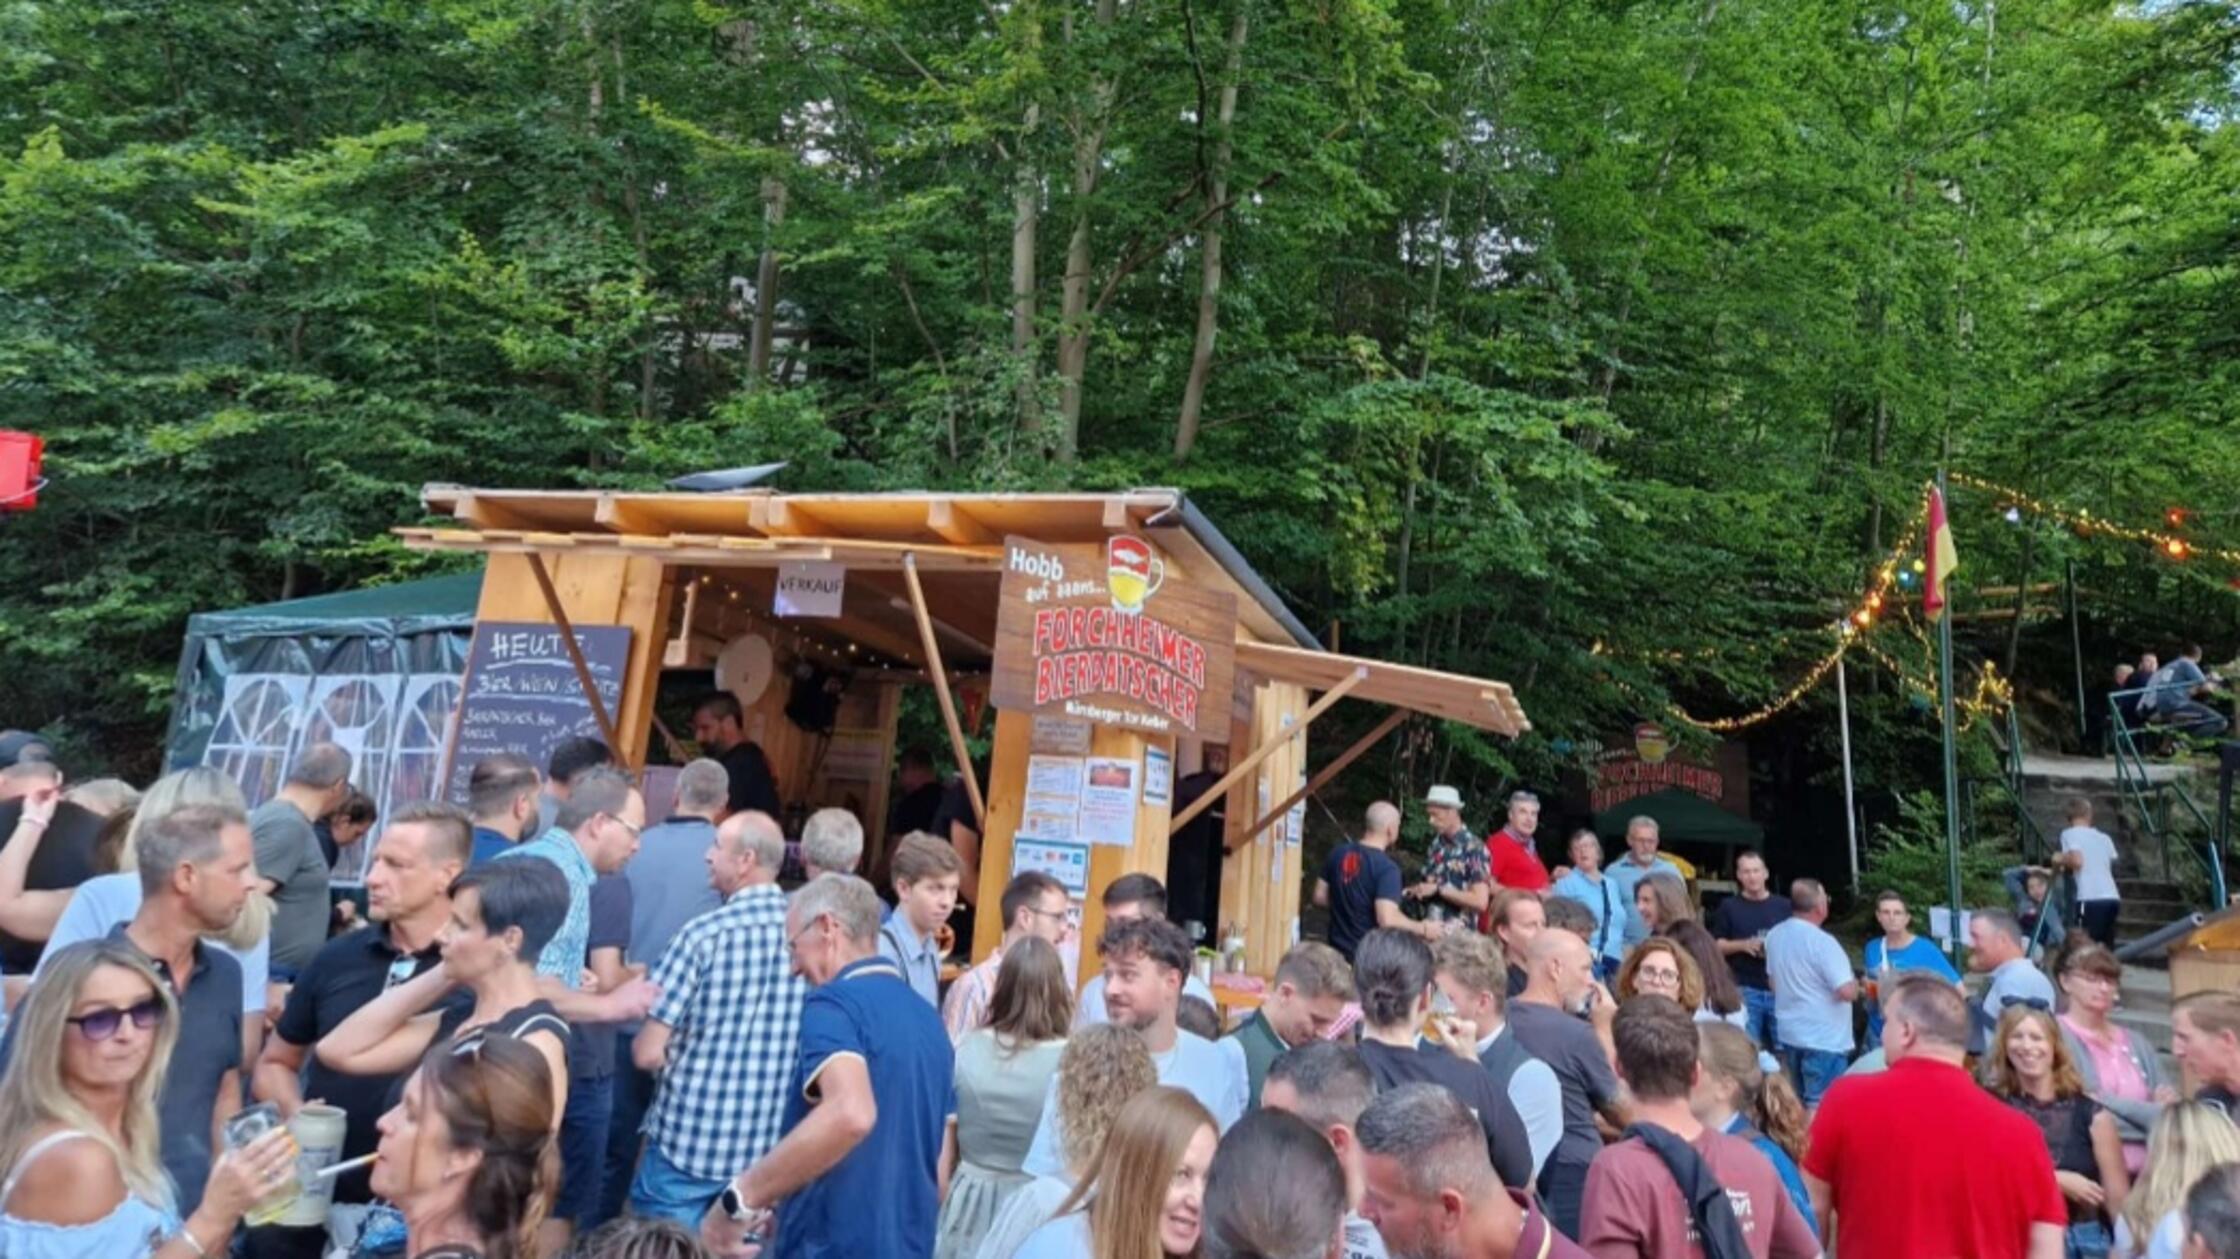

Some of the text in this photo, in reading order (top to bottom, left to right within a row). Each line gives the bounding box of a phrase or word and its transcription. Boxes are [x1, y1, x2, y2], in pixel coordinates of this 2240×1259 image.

[1010, 547, 1063, 581] Hobb
[780, 575, 841, 593] VERKAUF
[1034, 607, 1206, 689] FORCHHEIMER
